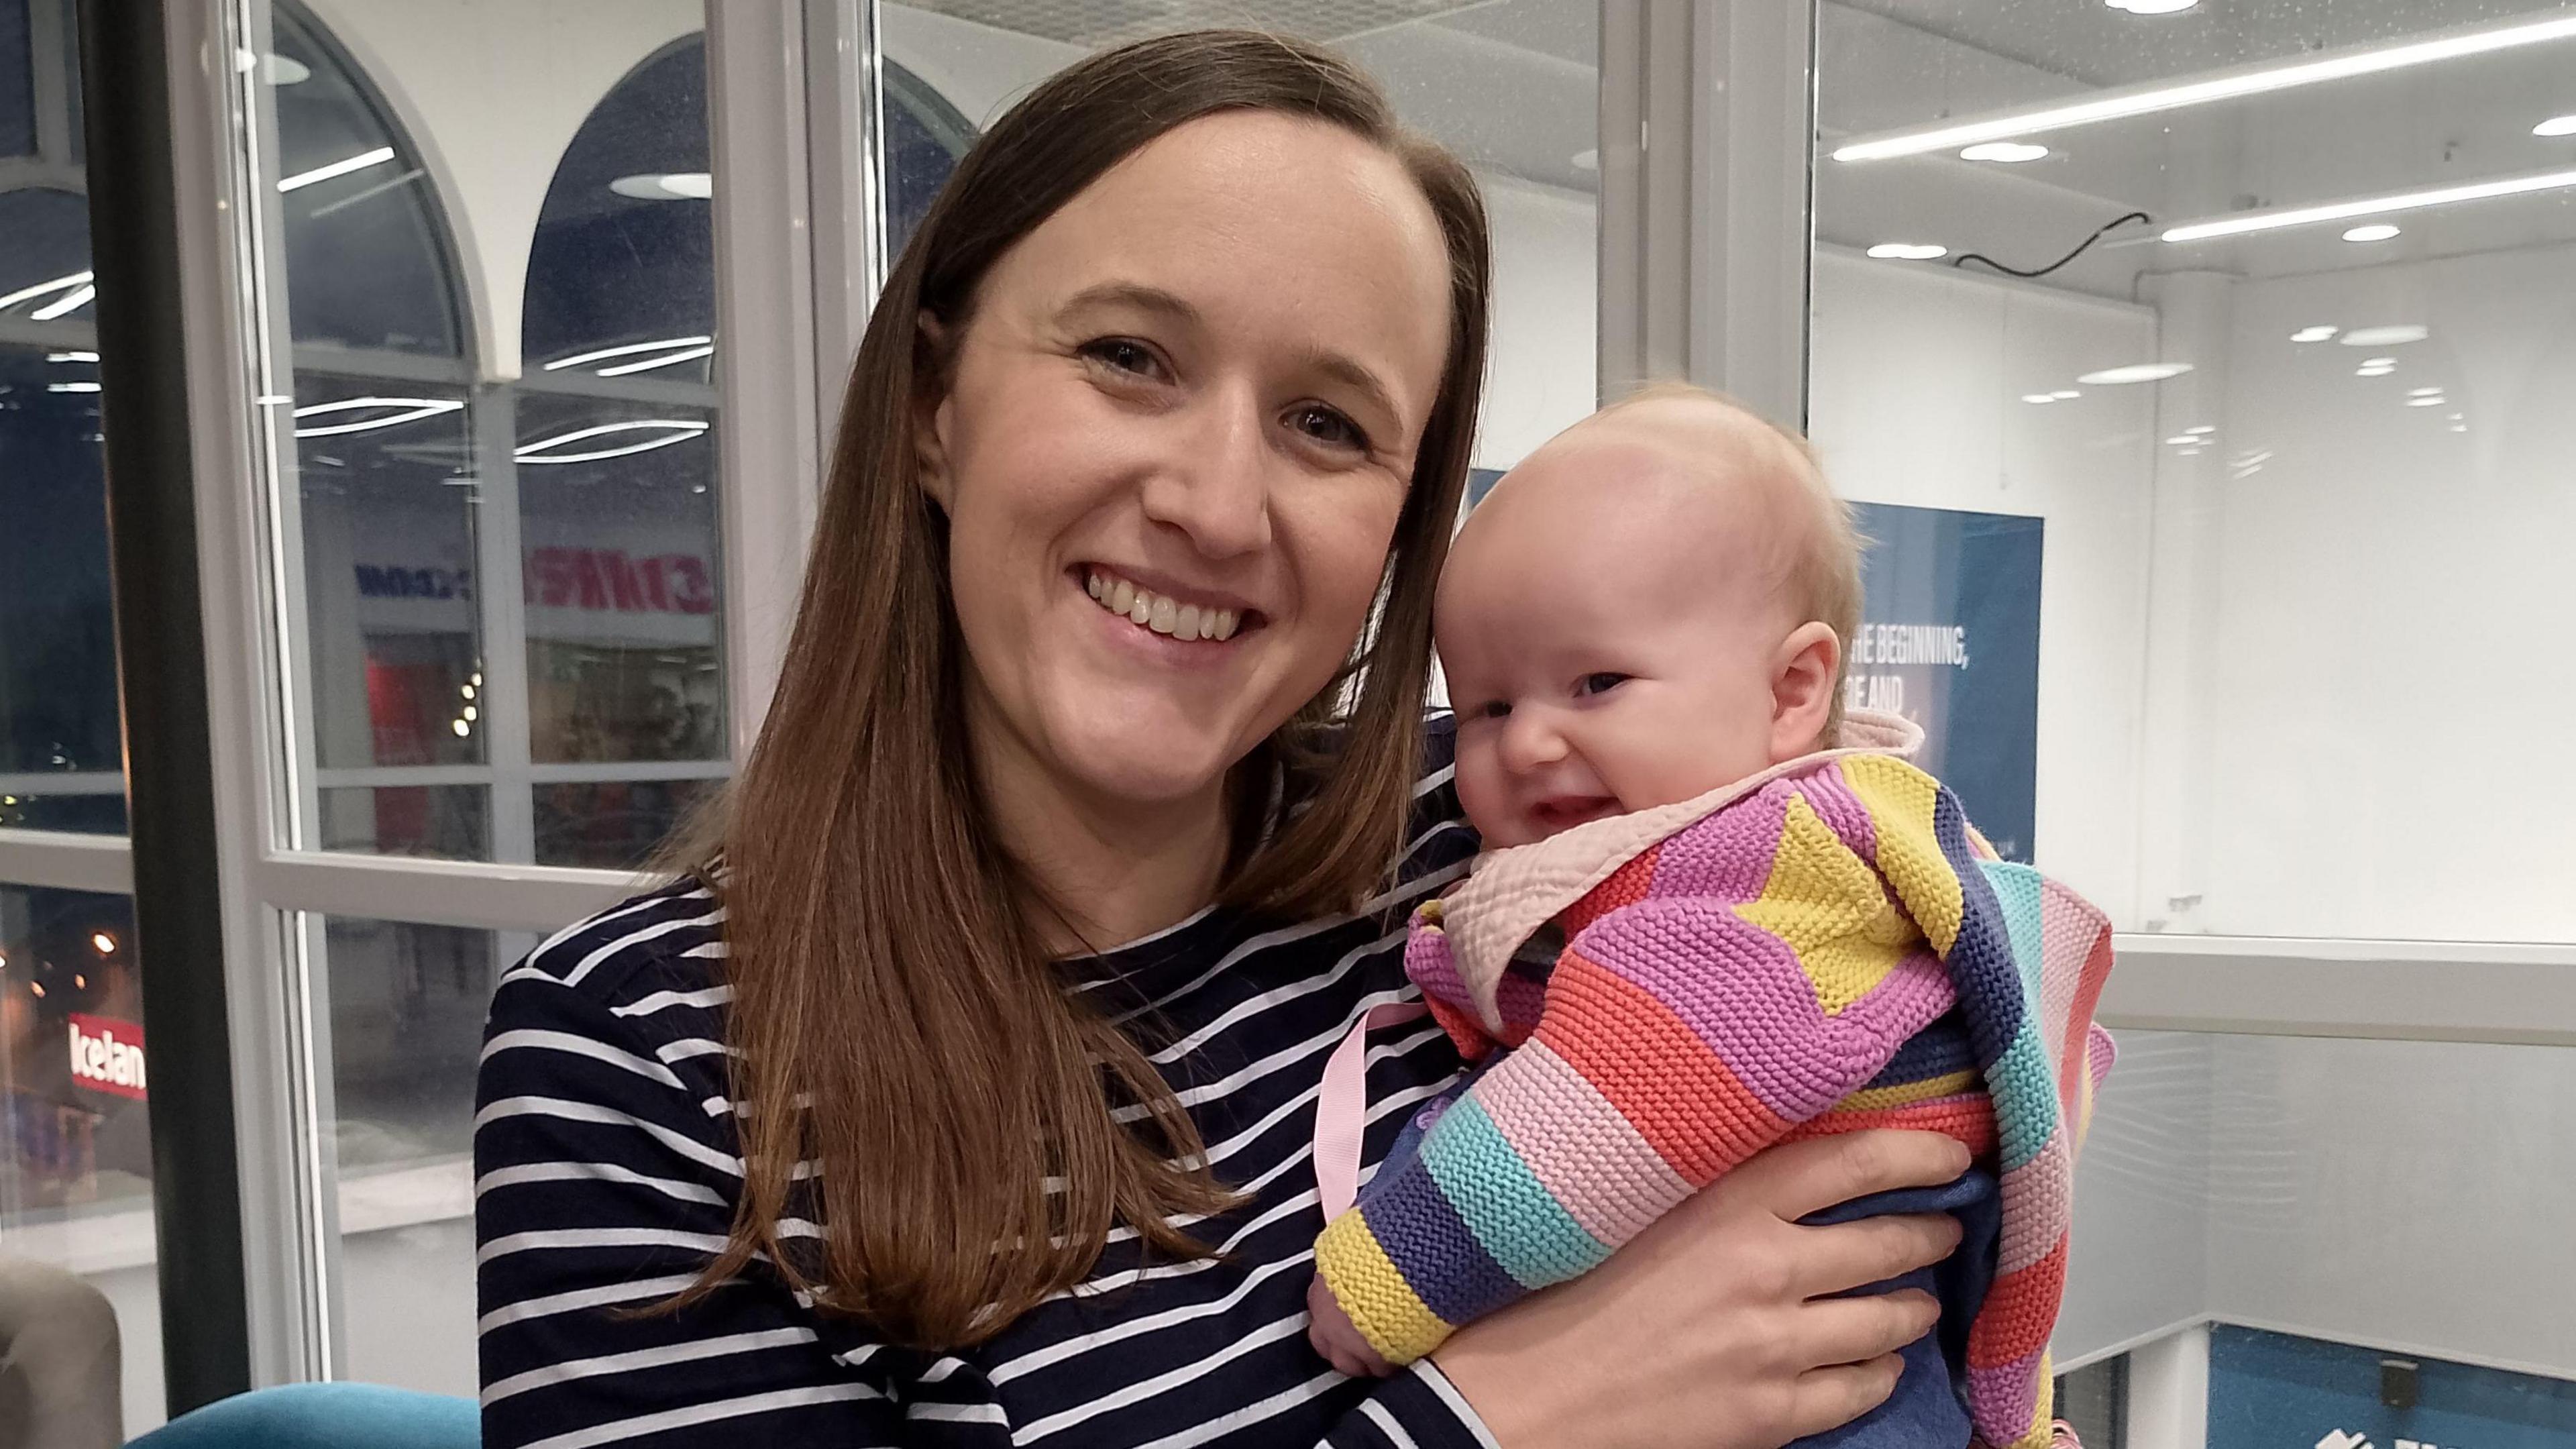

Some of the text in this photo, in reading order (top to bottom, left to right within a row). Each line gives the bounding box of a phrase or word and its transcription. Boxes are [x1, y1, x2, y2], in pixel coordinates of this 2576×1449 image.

[1851, 625, 1970, 669] HE BEGINNING,
[1868, 676, 1902, 713] AND
[68, 1023, 146, 1089] Icelan
